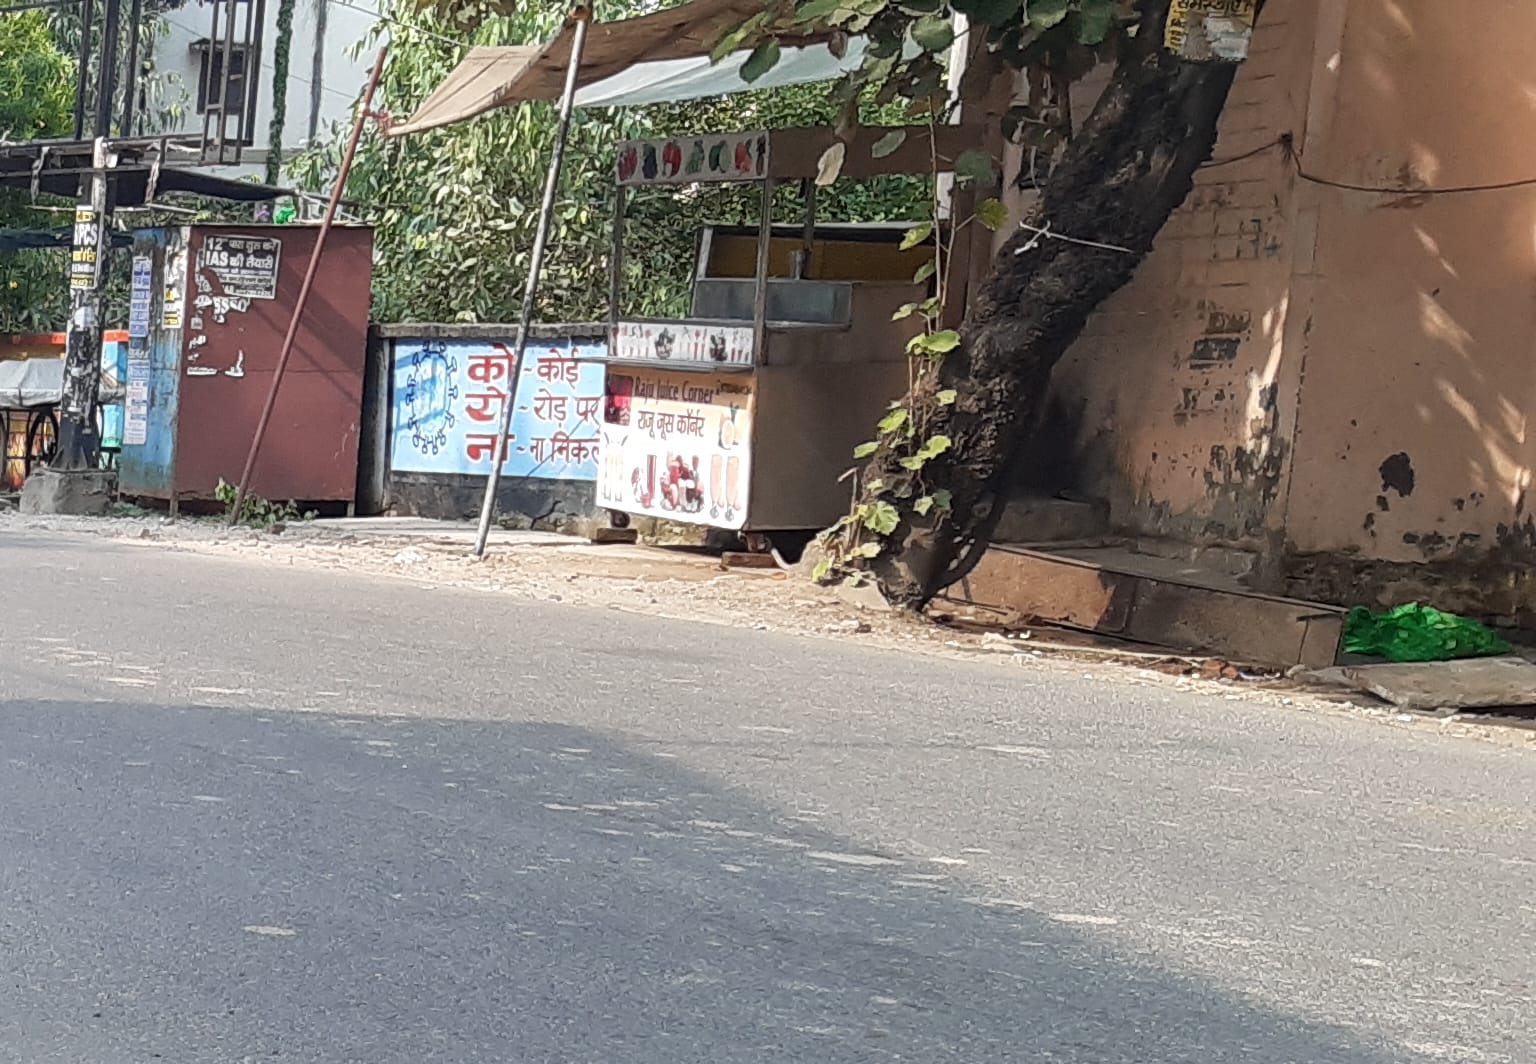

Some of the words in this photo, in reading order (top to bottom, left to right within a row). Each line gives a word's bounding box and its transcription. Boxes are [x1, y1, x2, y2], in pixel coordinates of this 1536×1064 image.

[206, 251, 228, 266] IAS
[230, 253, 244, 268] की
[468, 344, 514, 383] को
[537, 348, 580, 388] कोई
[634, 376, 654, 405] Raju
[656, 377, 678, 404] Juice
[682, 380, 713, 403] Corner
[638, 410, 655, 439] राजू
[657, 412, 675, 440] जूस
